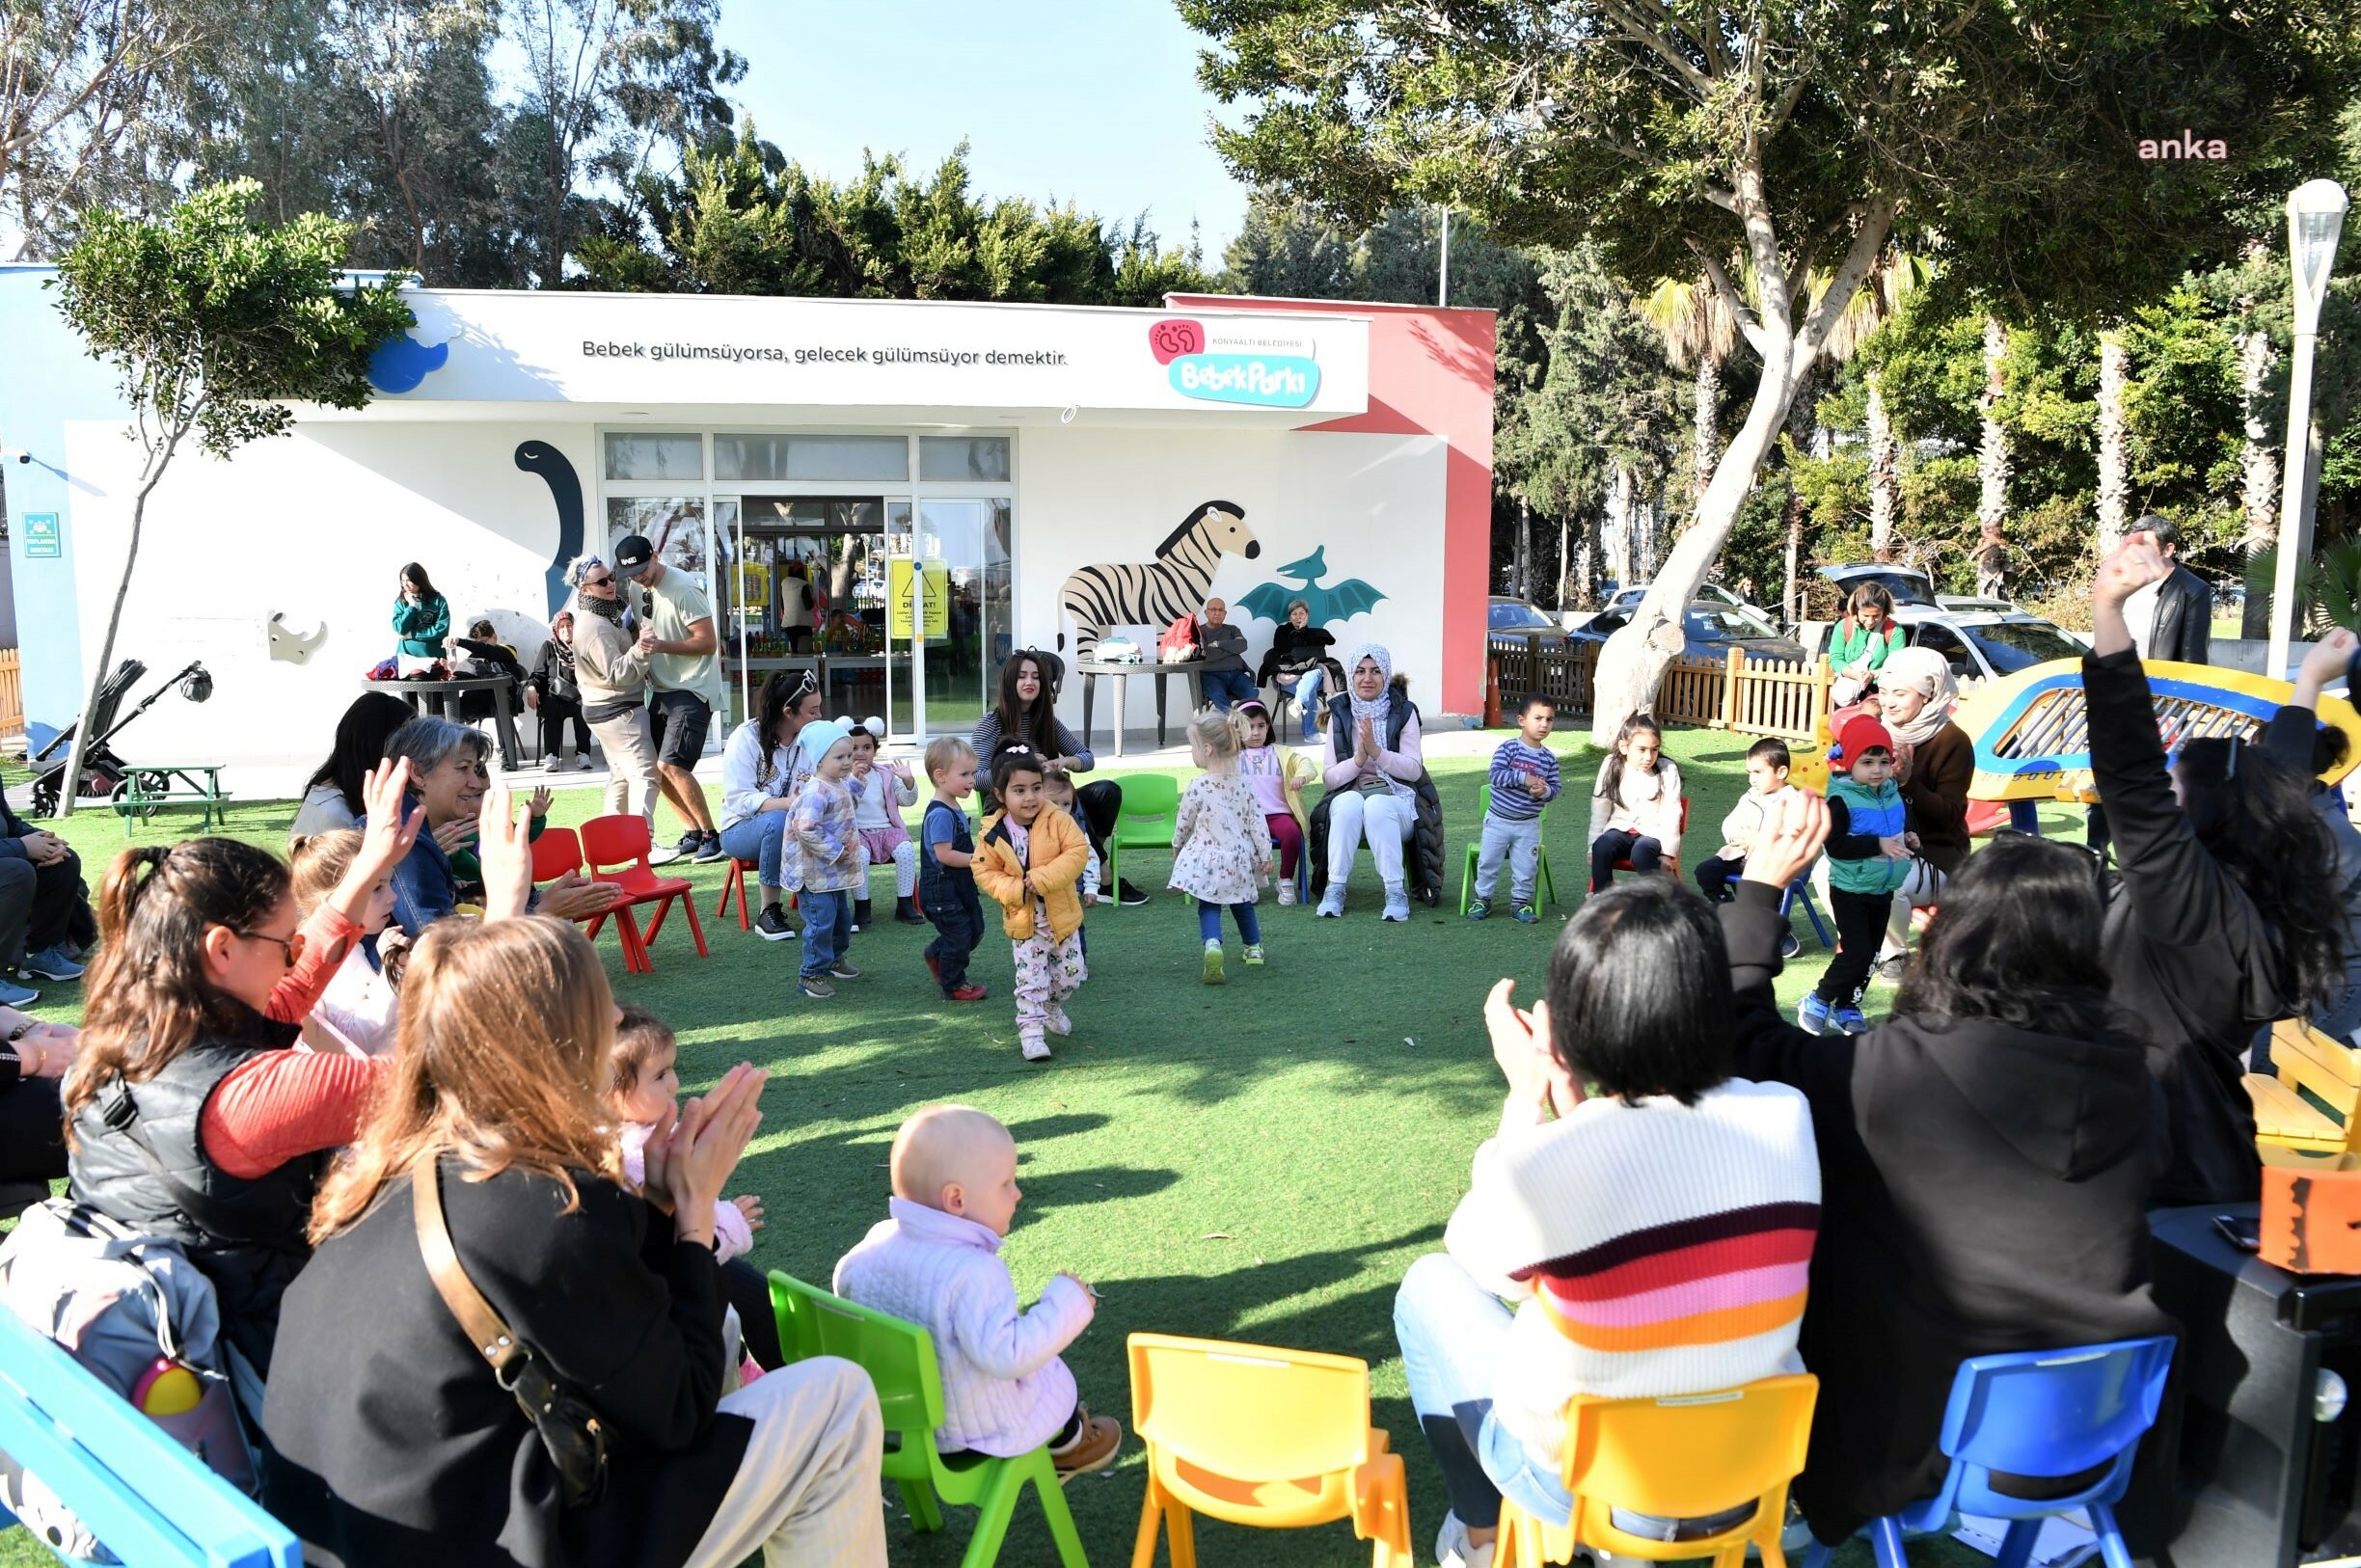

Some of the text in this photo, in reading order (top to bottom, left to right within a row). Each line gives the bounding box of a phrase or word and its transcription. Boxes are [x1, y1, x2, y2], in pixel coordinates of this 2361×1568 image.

[1212, 338, 1256, 346] KONYAALTI
[583, 340, 643, 357] Bebek
[794, 346, 866, 364] gelecek
[872, 347, 979, 366] gülümsüyor
[985, 349, 1067, 365] demektir.
